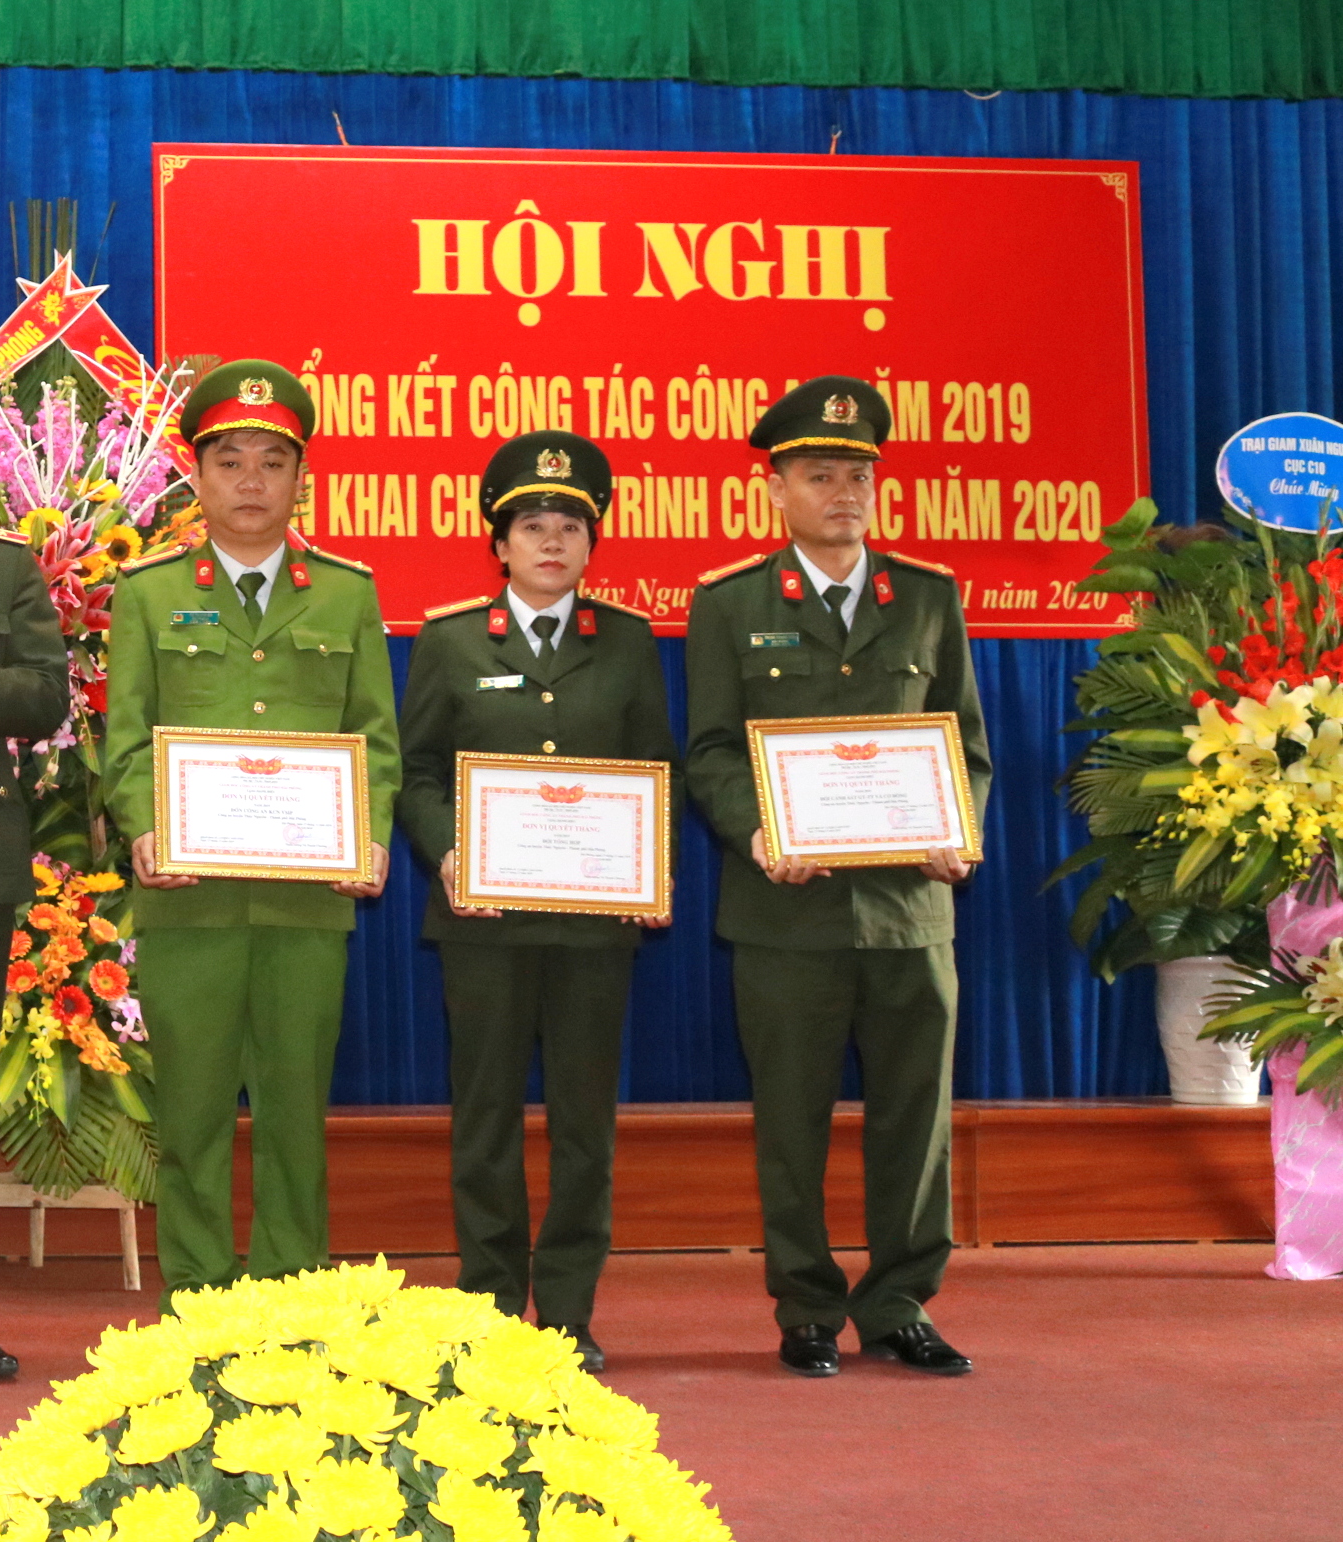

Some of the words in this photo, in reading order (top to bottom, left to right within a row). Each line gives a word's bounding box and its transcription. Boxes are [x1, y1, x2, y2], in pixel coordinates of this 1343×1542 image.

[412, 199, 608, 327] HỘI
[633, 218, 893, 332] NGHỊ
[295, 348, 376, 437] ỔNG
[388, 354, 457, 437] KẾT
[469, 362, 573, 438] CÔNG
[583, 363, 655, 439] TÁC
[667, 364, 769, 440] CÔNG
[864, 366, 931, 442] ĂM
[942, 381, 1031, 444] 2019
[1240, 437, 1265, 454] TRẠI
[1268, 437, 1296, 451] GIAM
[1299, 436, 1325, 454] XUÂN
[1284, 459, 1306, 476] CỤC
[328, 474, 418, 537] KHAI
[721, 463, 792, 540] CÔ
[915, 465, 1002, 541] NĂM
[1013, 479, 1101, 542] 2020
[1269, 478, 1304, 495] Chúc
[576, 577, 626, 604] hủy
[982, 580, 1038, 610] năm
